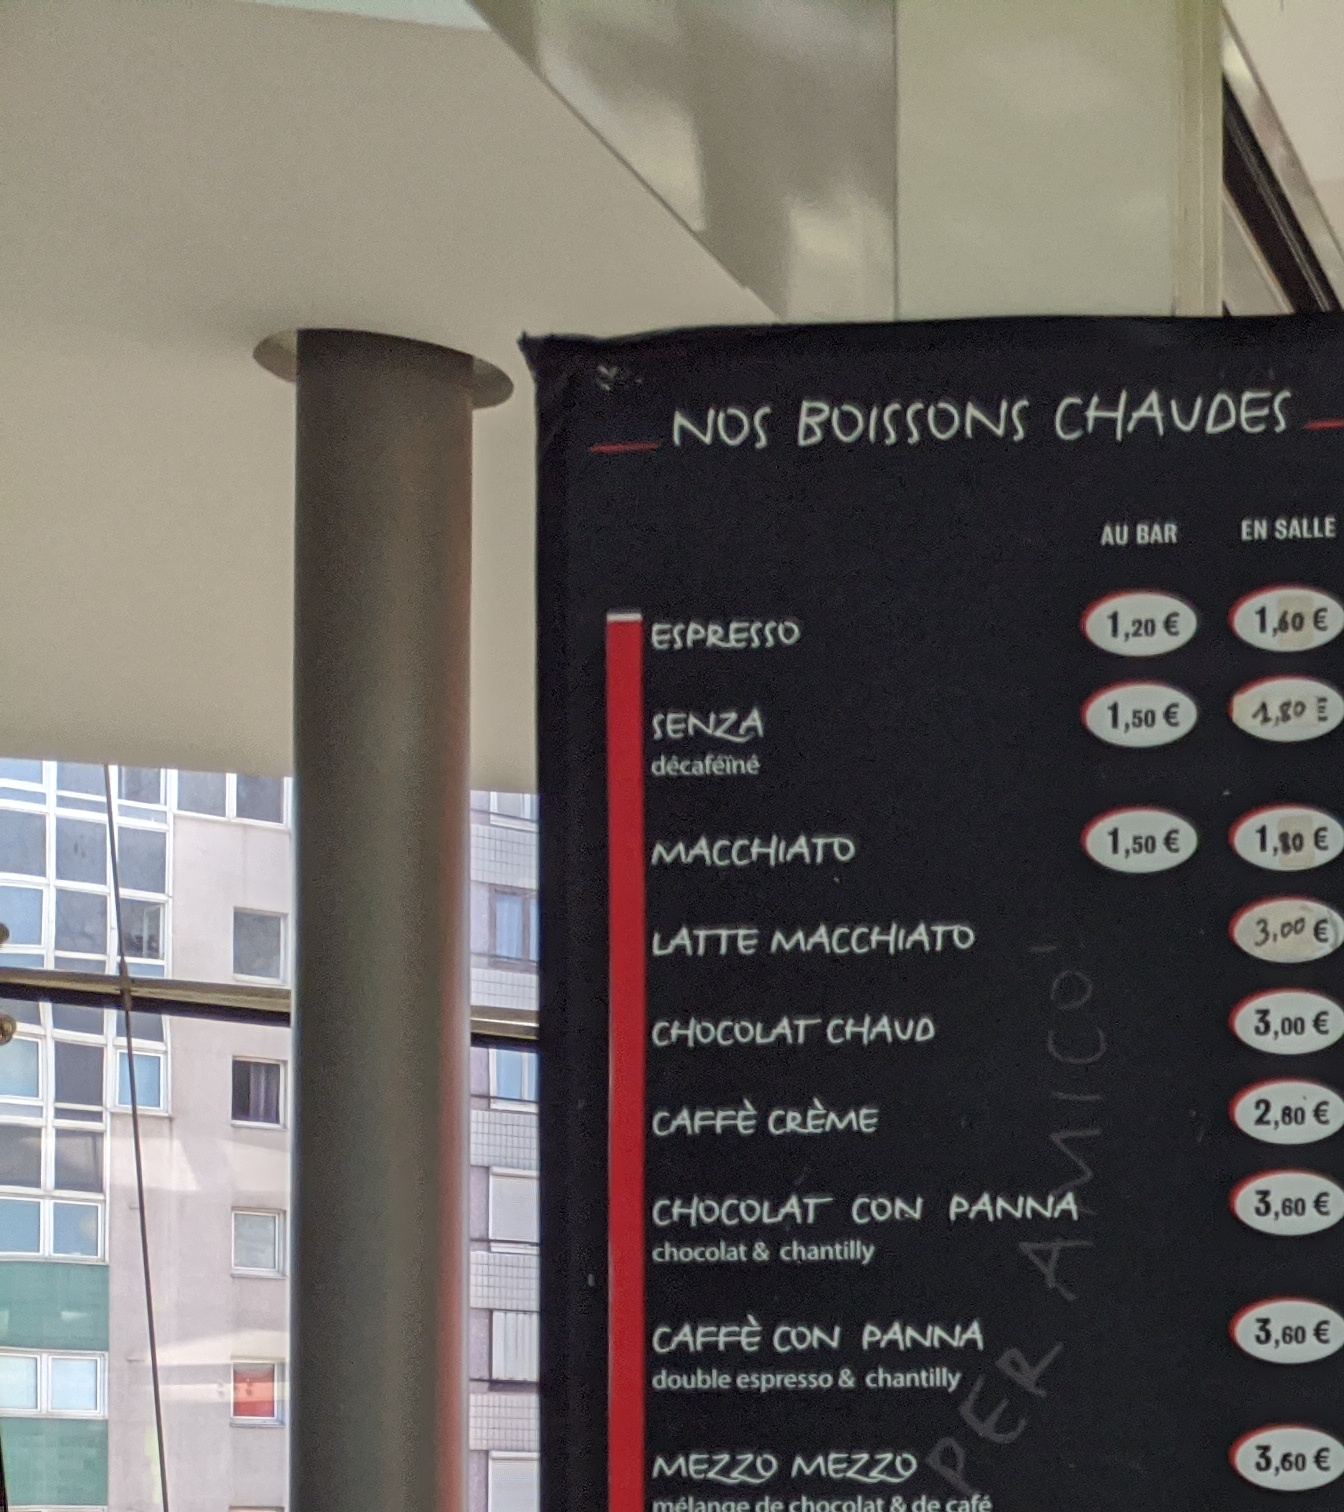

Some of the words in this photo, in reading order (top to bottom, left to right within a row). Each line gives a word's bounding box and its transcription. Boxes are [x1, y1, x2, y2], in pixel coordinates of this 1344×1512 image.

[672, 406, 771, 449] NOS
[797, 398, 1029, 447] BOISSONS
[1054, 389, 1291, 441] CHAUDES
[1101, 524, 1129, 546] AU
[1136, 522, 1178, 545] BAR
[1241, 519, 1268, 541] EN
[1274, 516, 1335, 540] SALLE
[651, 620, 800, 650] ESPRESSO
[1107, 610, 1157, 642] 1,20
[1162, 611, 1180, 637] €
[1311, 606, 1328, 632] €
[652, 708, 764, 743] SENZA
[1107, 700, 1157, 733] 1,50
[1162, 702, 1180, 728] €
[651, 834, 856, 866] MACCHIATO
[1107, 826, 1157, 859] 1,50
[1162, 828, 1180, 854] €
[1312, 825, 1329, 852] €
[652, 926, 759, 956] LATTE
[770, 922, 975, 954] MACCHIATO
[1312, 917, 1330, 944] €
[651, 1016, 822, 1047] CHOCOLAT
[826, 1014, 936, 1045] CHAUD
[1253, 1008, 1306, 1039] 3,00
[1312, 1009, 1330, 1036] €
[652, 1098, 757, 1137] CAFFÈ
[767, 1097, 878, 1135] CRÈME
[1254, 1097, 1306, 1129] 2,80
[1312, 1099, 1330, 1126] €
[652, 1194, 833, 1227] CHOCOLAT
[851, 1196, 924, 1225] CON
[949, 1191, 1078, 1222] PANNA
[1254, 1188, 1307, 1220] 3,60
[1312, 1190, 1331, 1217] €
[652, 1241, 747, 1262] chocolat
[752, 1241, 770, 1261] &
[779, 1239, 875, 1265] chantilly
[652, 1314, 762, 1354] CAFFÈ
[772, 1325, 841, 1353] CON
[861, 1320, 984, 1351] PANNA
[1254, 1316, 1307, 1348] 3,60
[1312, 1319, 1331, 1345] €
[652, 1368, 732, 1390] double
[736, 1373, 834, 1393] espresso
[838, 1368, 855, 1388] &
[865, 1366, 961, 1392] chantilly
[652, 1452, 778, 1485] MEZZO
[791, 1451, 918, 1484] MEZZO
[1254, 1444, 1307, 1476] 3,60
[1312, 1446, 1331, 1472] €
